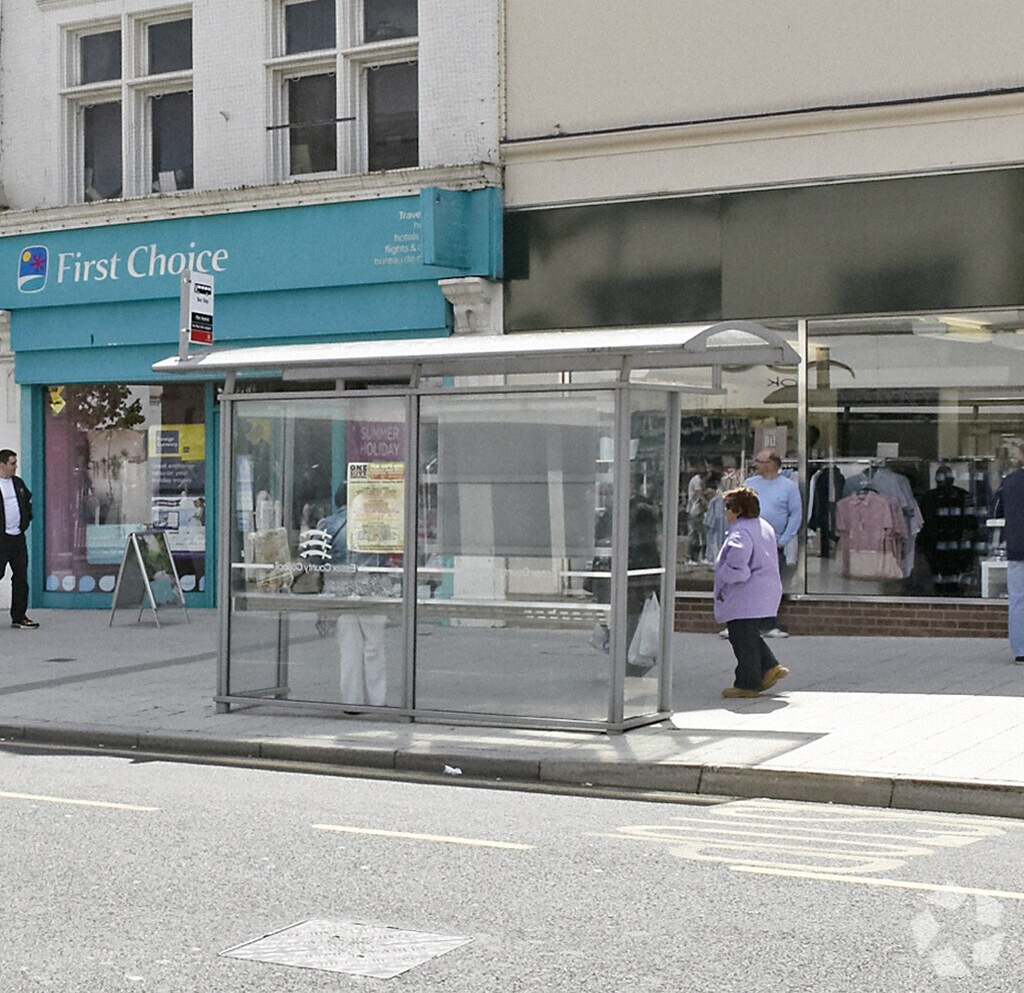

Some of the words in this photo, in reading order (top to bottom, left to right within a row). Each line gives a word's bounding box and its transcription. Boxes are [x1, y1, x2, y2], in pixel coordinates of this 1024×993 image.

[399, 211, 422, 220] Trave
[57, 252, 121, 283] First
[127, 241, 229, 278] Choice
[360, 426, 400, 441] SUMMER
[360, 442, 400, 456] HOLIDAY
